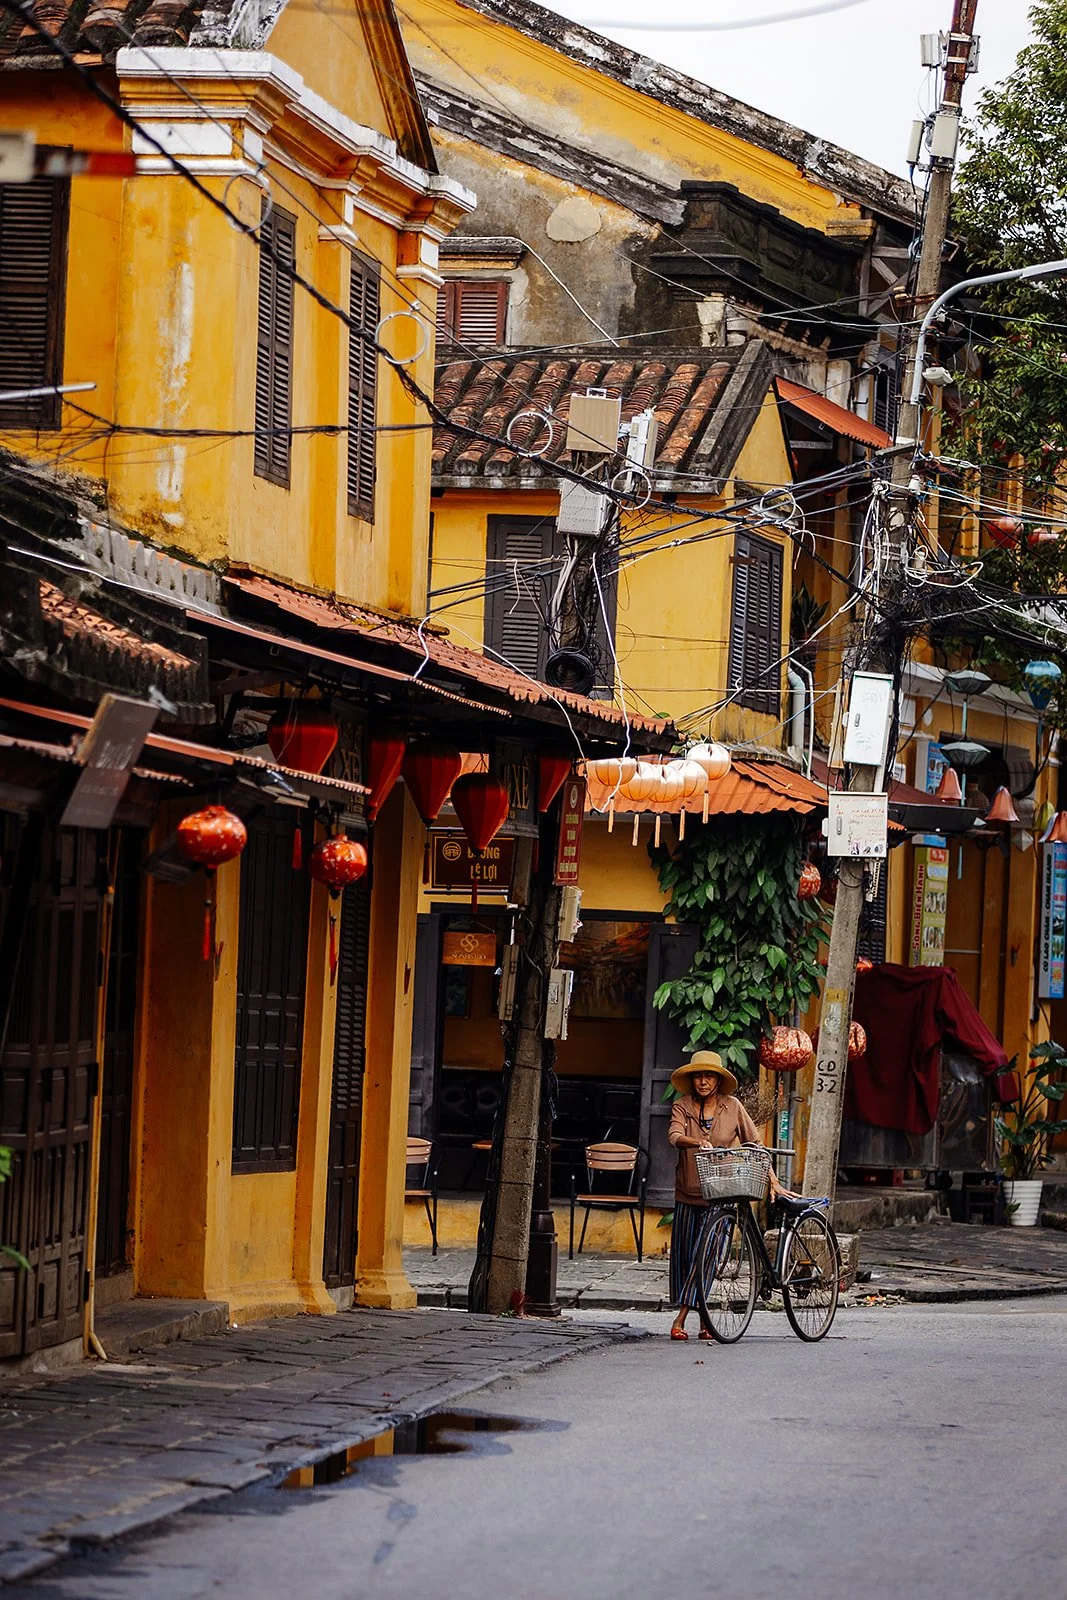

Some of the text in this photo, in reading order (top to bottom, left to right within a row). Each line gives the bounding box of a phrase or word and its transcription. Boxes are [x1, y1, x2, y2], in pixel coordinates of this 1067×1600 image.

[467, 846, 500, 859] ĐNG
[483, 864, 497, 882] LỢI
[817, 1060, 837, 1072] CD
[816, 1077, 837, 1094] 3-2
